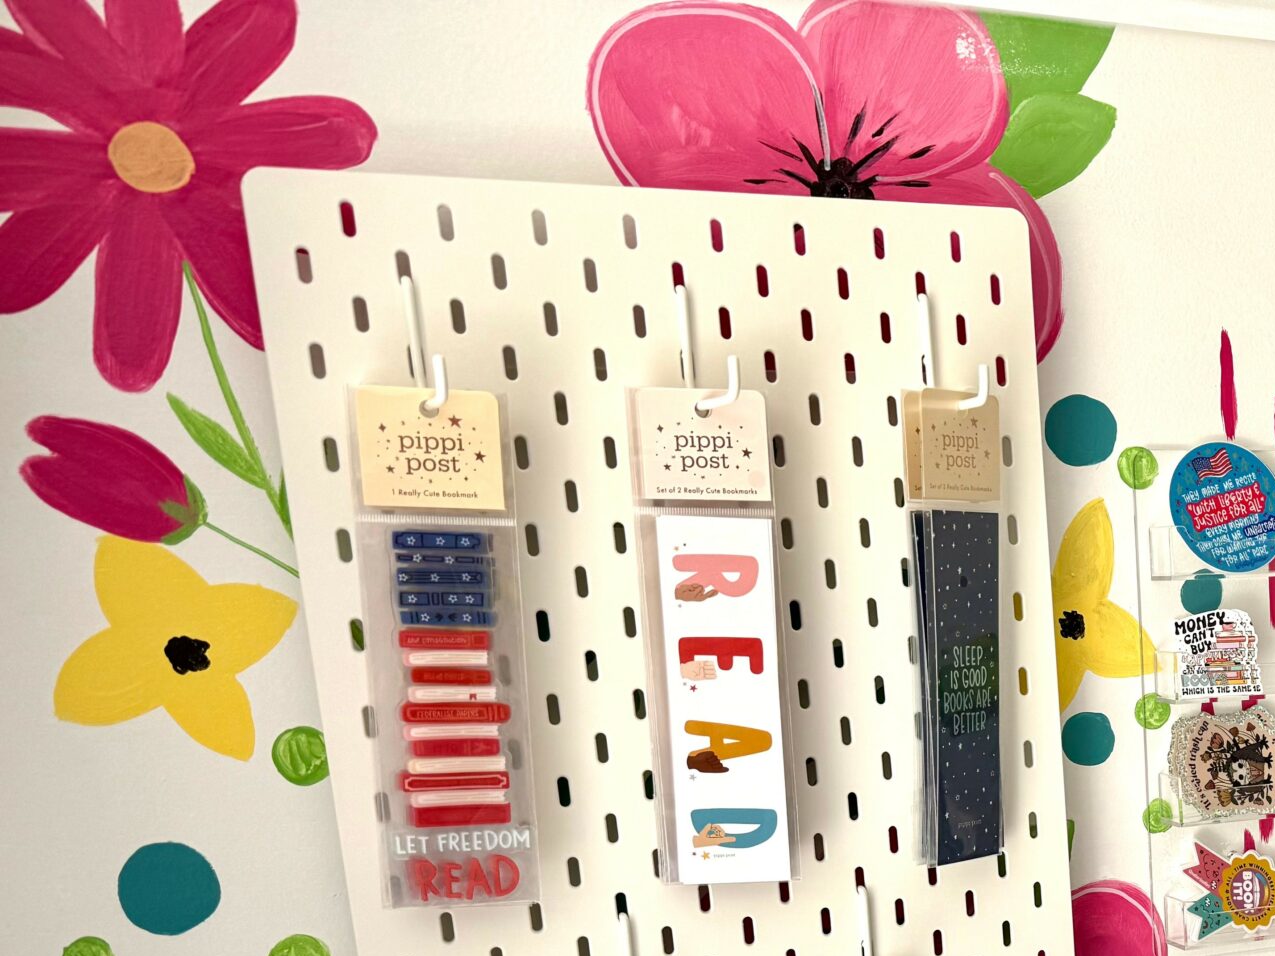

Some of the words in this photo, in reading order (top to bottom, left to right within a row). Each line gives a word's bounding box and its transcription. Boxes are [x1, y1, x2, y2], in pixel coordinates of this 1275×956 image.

[398, 431, 465, 455] pippi
[674, 430, 733, 452] pippi
[941, 430, 980, 453] pippi
[405, 456, 461, 475] post
[680, 453, 730, 472] post
[946, 453, 977, 471] post
[398, 489, 421, 499] Really
[423, 490, 440, 498] Cute
[442, 490, 478, 499] Bookmark
[656, 486, 668, 494] Set
[678, 486, 682, 494] 2
[684, 487, 704, 495] Really
[1174, 611, 1225, 635] MONEY
[953, 645, 984, 668] SLEEP
[1191, 640, 1212, 655] BUY
[950, 668, 960, 690] IS
[961, 665, 988, 689] GOOD
[943, 689, 975, 714] BOOKS
[976, 687, 992, 707] ARE
[1182, 687, 1205, 695] WHICH
[1217, 686, 1230, 694] THE
[1233, 685, 1252, 693] SAME
[953, 710, 987, 736] BETTER
[1189, 737, 1203, 762] trash
[1198, 720, 1209, 736] can
[395, 833, 429, 855] LET
[437, 829, 532, 853] FREEDOM
[414, 853, 521, 903] READ
[1233, 882, 1243, 900] IT!
[1242, 871, 1254, 913] BOOK
